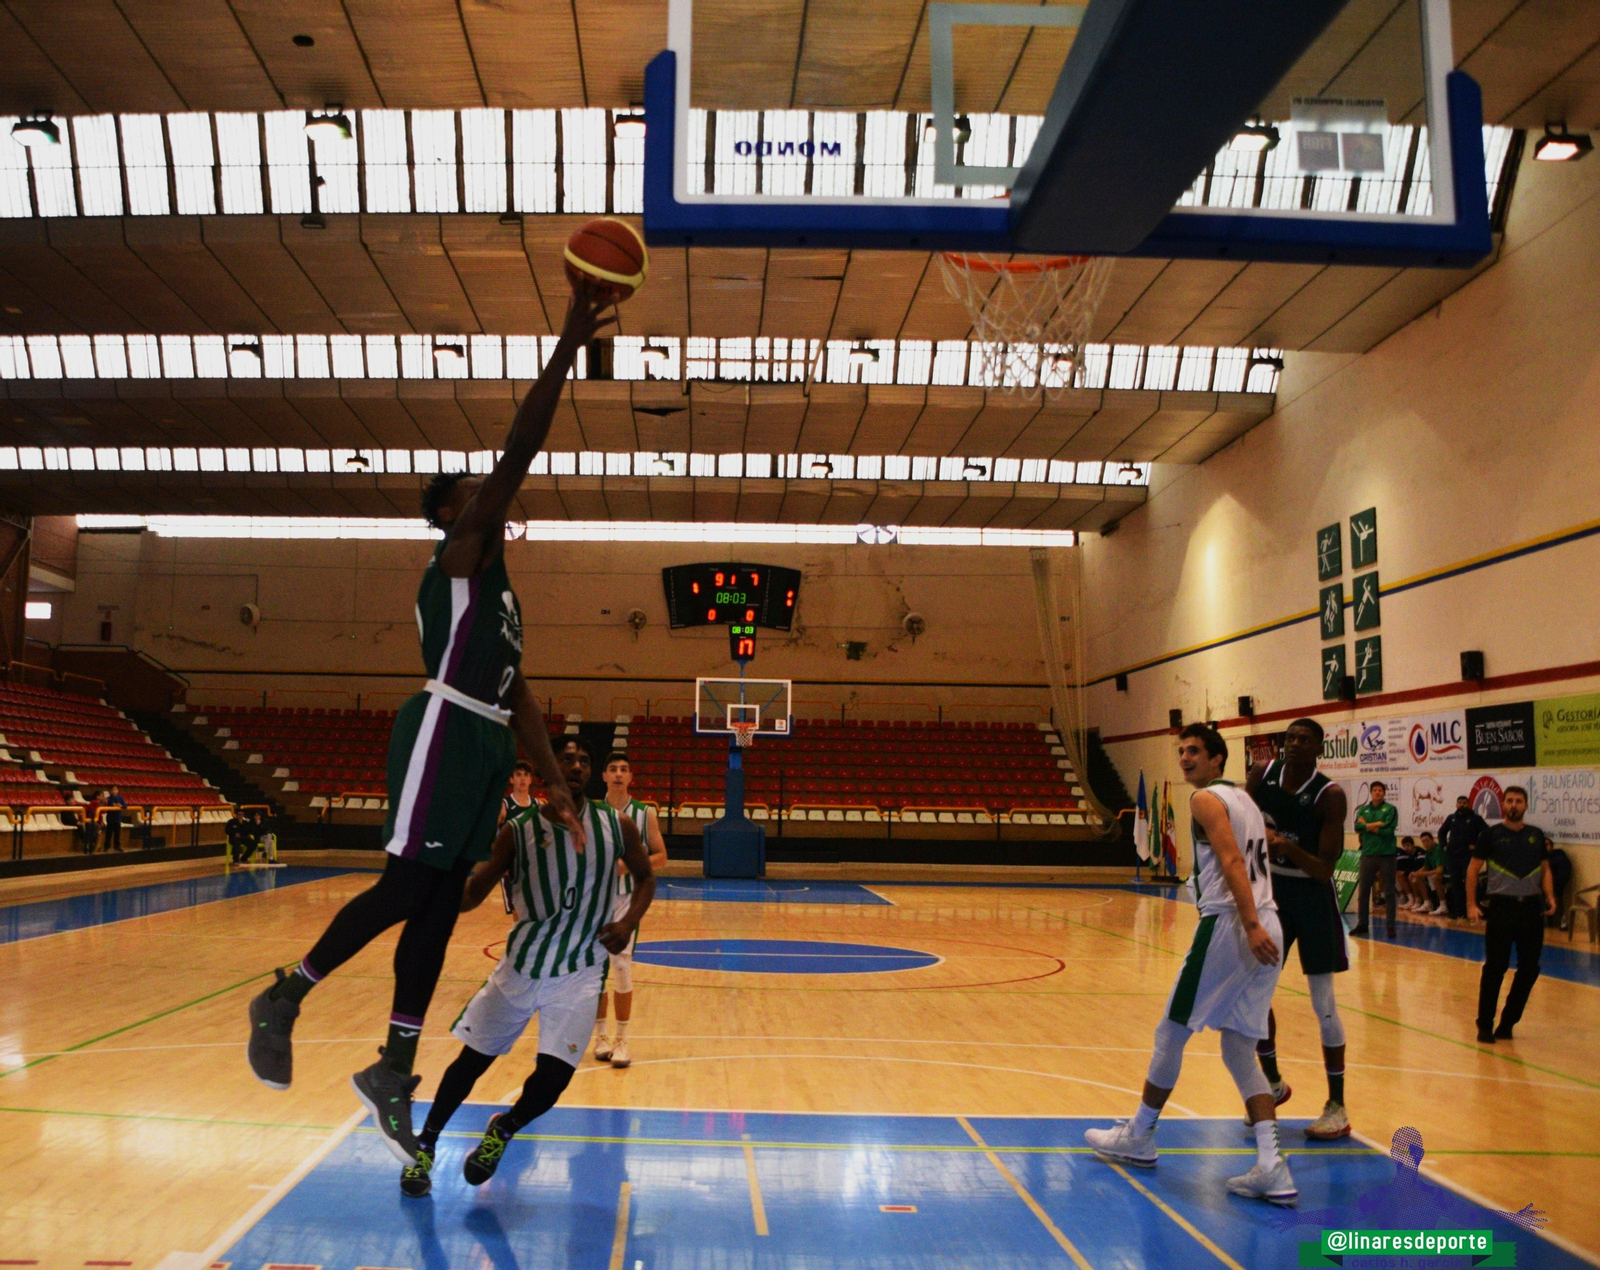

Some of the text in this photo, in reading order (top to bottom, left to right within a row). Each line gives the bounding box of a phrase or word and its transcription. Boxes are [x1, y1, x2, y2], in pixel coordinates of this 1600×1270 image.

[714, 571, 725, 587] 9
[750, 572, 759, 587] 7
[716, 592, 746, 604] 08:03
[1430, 719, 1462, 746] MLC
[1475, 726, 1524, 745] BUEN SABOR
[1318, 728, 1358, 760] ástulo
[1360, 752, 1387, 762] CRISTIAN
[1542, 772, 1596, 789] BALNEARIO
